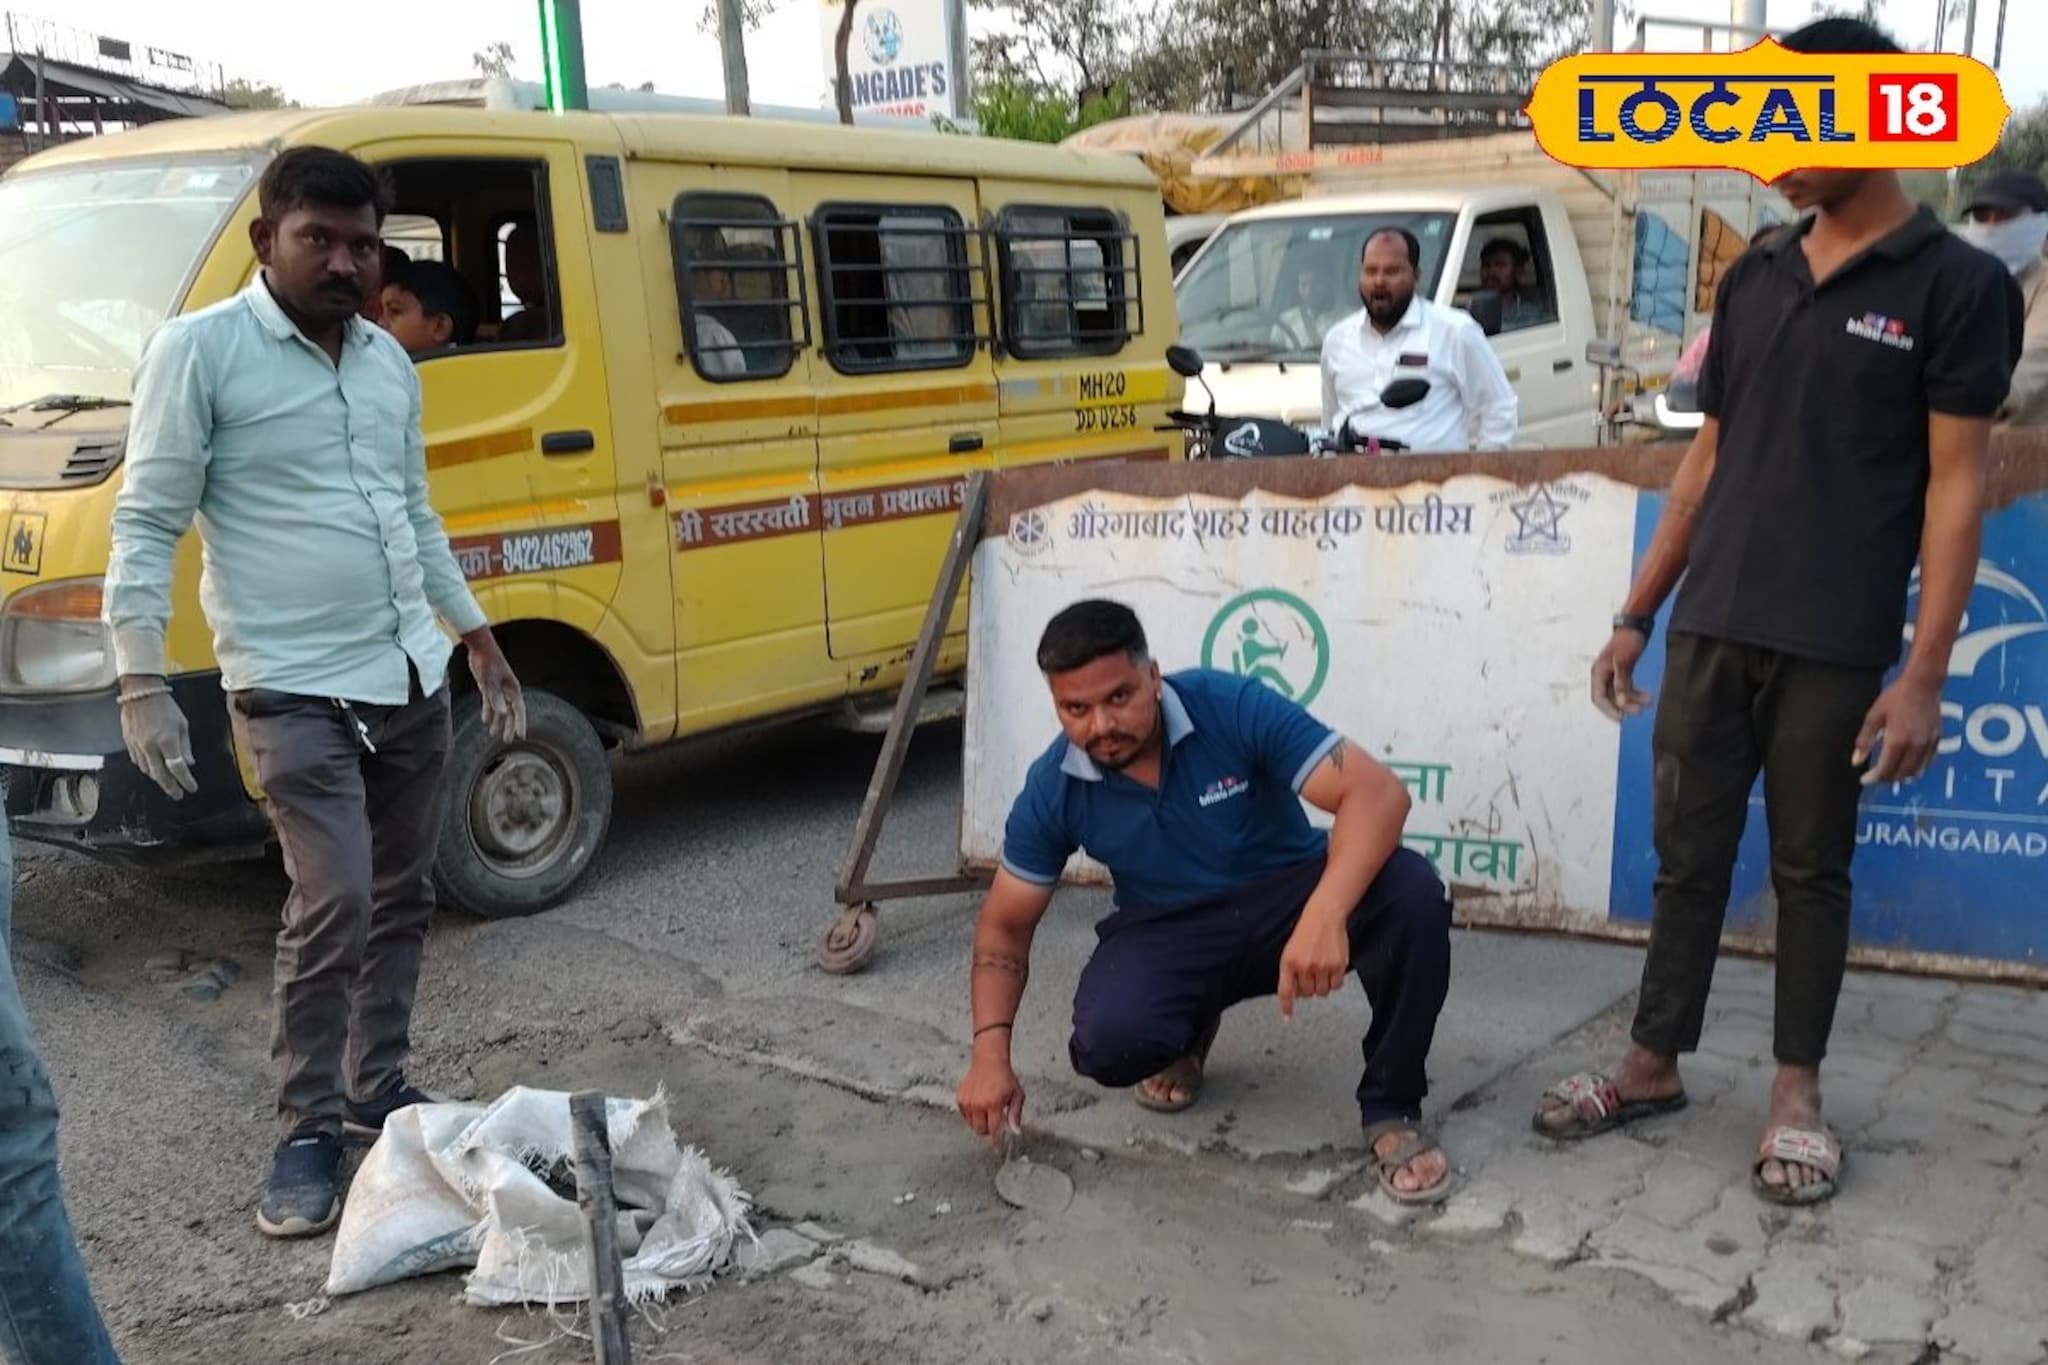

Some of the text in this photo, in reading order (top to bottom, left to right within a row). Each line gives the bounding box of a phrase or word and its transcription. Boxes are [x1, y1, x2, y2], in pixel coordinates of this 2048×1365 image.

[1079, 371, 1127, 401] MH20
[1067, 499, 1187, 541] औरंगाबाद
[1191, 508, 1252, 541] शहर
[1260, 505, 1365, 551] वाहतूक
[1374, 492, 1476, 536] पोलीस
[1403, 833, 1525, 884] रावा
[1856, 822, 2048, 858] URANGABAD
